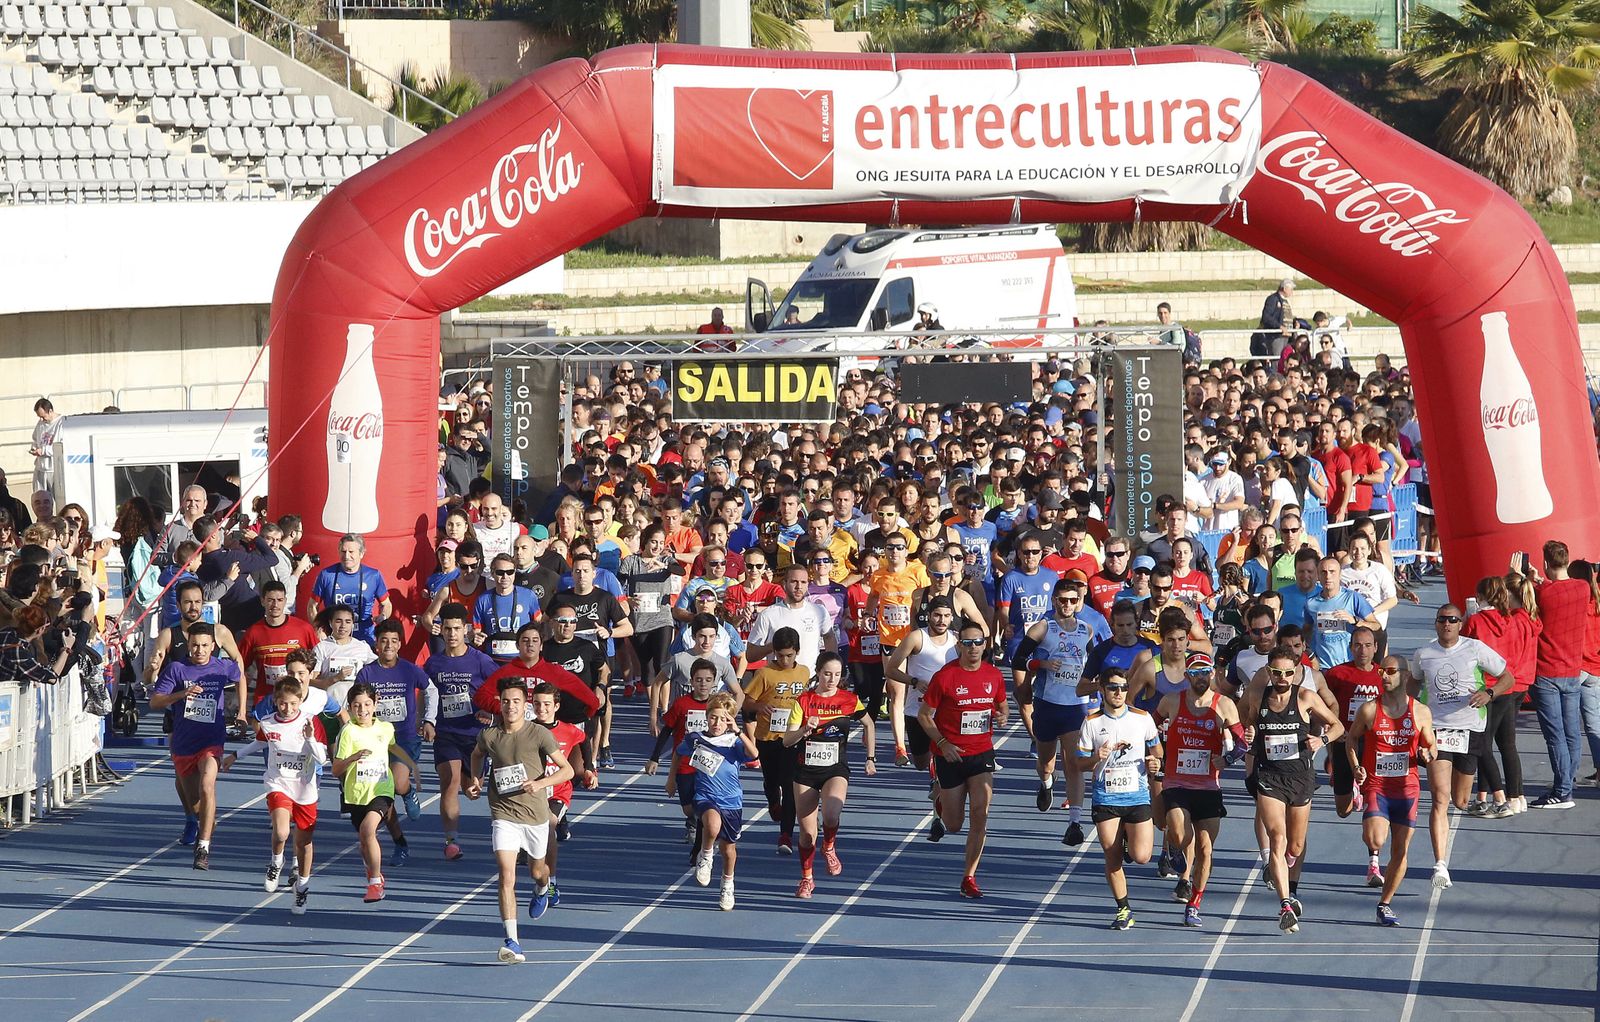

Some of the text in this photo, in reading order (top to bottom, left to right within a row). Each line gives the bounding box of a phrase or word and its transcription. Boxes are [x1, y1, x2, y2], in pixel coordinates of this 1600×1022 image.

[855, 86, 1242, 150] entreculturas
[856, 162, 1241, 182] ONG JESUITA PARA LA EDUCACIÓN Y EL DESARROLLO
[403, 119, 585, 277] Coca-Cola
[1258, 131, 1471, 257] Coca-Cola
[677, 363, 836, 404] SALIDA
[502, 367, 513, 420] deportivos
[513, 366, 533, 450] Tempo
[503, 421, 512, 460] eventos
[1134, 357, 1154, 529] Tempo Sport
[1124, 359, 1136, 536] Cronometraje de eventos deportivos
[1020, 595, 1049, 608] RCM
[890, 613, 902, 621] 112
[1324, 620, 1338, 628] 250
[447, 702, 465, 711] 4347
[973, 697, 994, 705] PEDRO
[192, 706, 211, 717] 4505
[381, 707, 401, 716] 4345
[1183, 735, 1205, 747] Vélez
[1384, 735, 1409, 746] Vélez
[1445, 737, 1460, 746] 405
[1274, 745, 1290, 754] 178
[696, 753, 714, 769] 4222
[811, 751, 832, 760] 4439
[282, 761, 303, 771] 4263
[1186, 759, 1202, 768] 317
[1383, 762, 1404, 771] 4508
[500, 774, 521, 786] 4343
[1112, 777, 1133, 786] 4287
